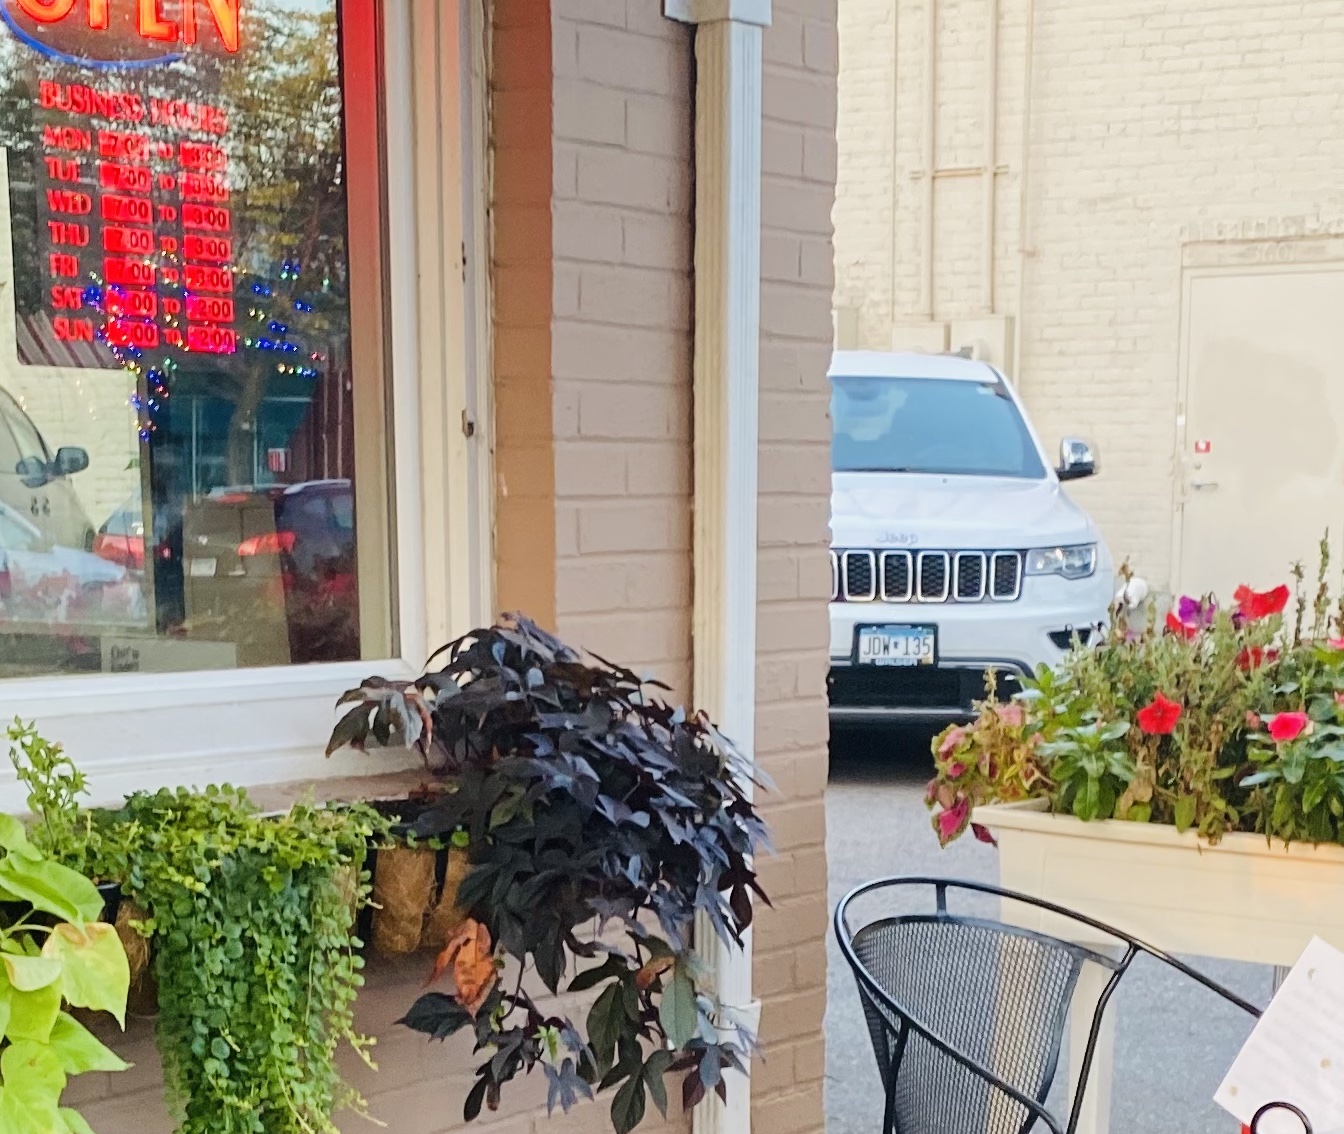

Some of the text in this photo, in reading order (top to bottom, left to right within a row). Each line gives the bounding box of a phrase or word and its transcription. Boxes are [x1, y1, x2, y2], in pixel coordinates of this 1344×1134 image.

[39, 80, 229, 136] BUSINESS HOURS
[43, 124, 92, 151] MON
[158, 174, 176, 190] TO
[46, 188, 92, 215] WED
[158, 205, 177, 221] TO
[47, 220, 90, 247] THU
[160, 236, 178, 251] TO
[49, 252, 79, 278] FRI
[160, 267, 179, 282] TO
[51, 285, 85, 311] SAT
[162, 298, 181, 314] TO
[53, 317, 94, 343] SUN
[164, 328, 182, 345] TO
[863, 636, 931, 656] JDW 135
